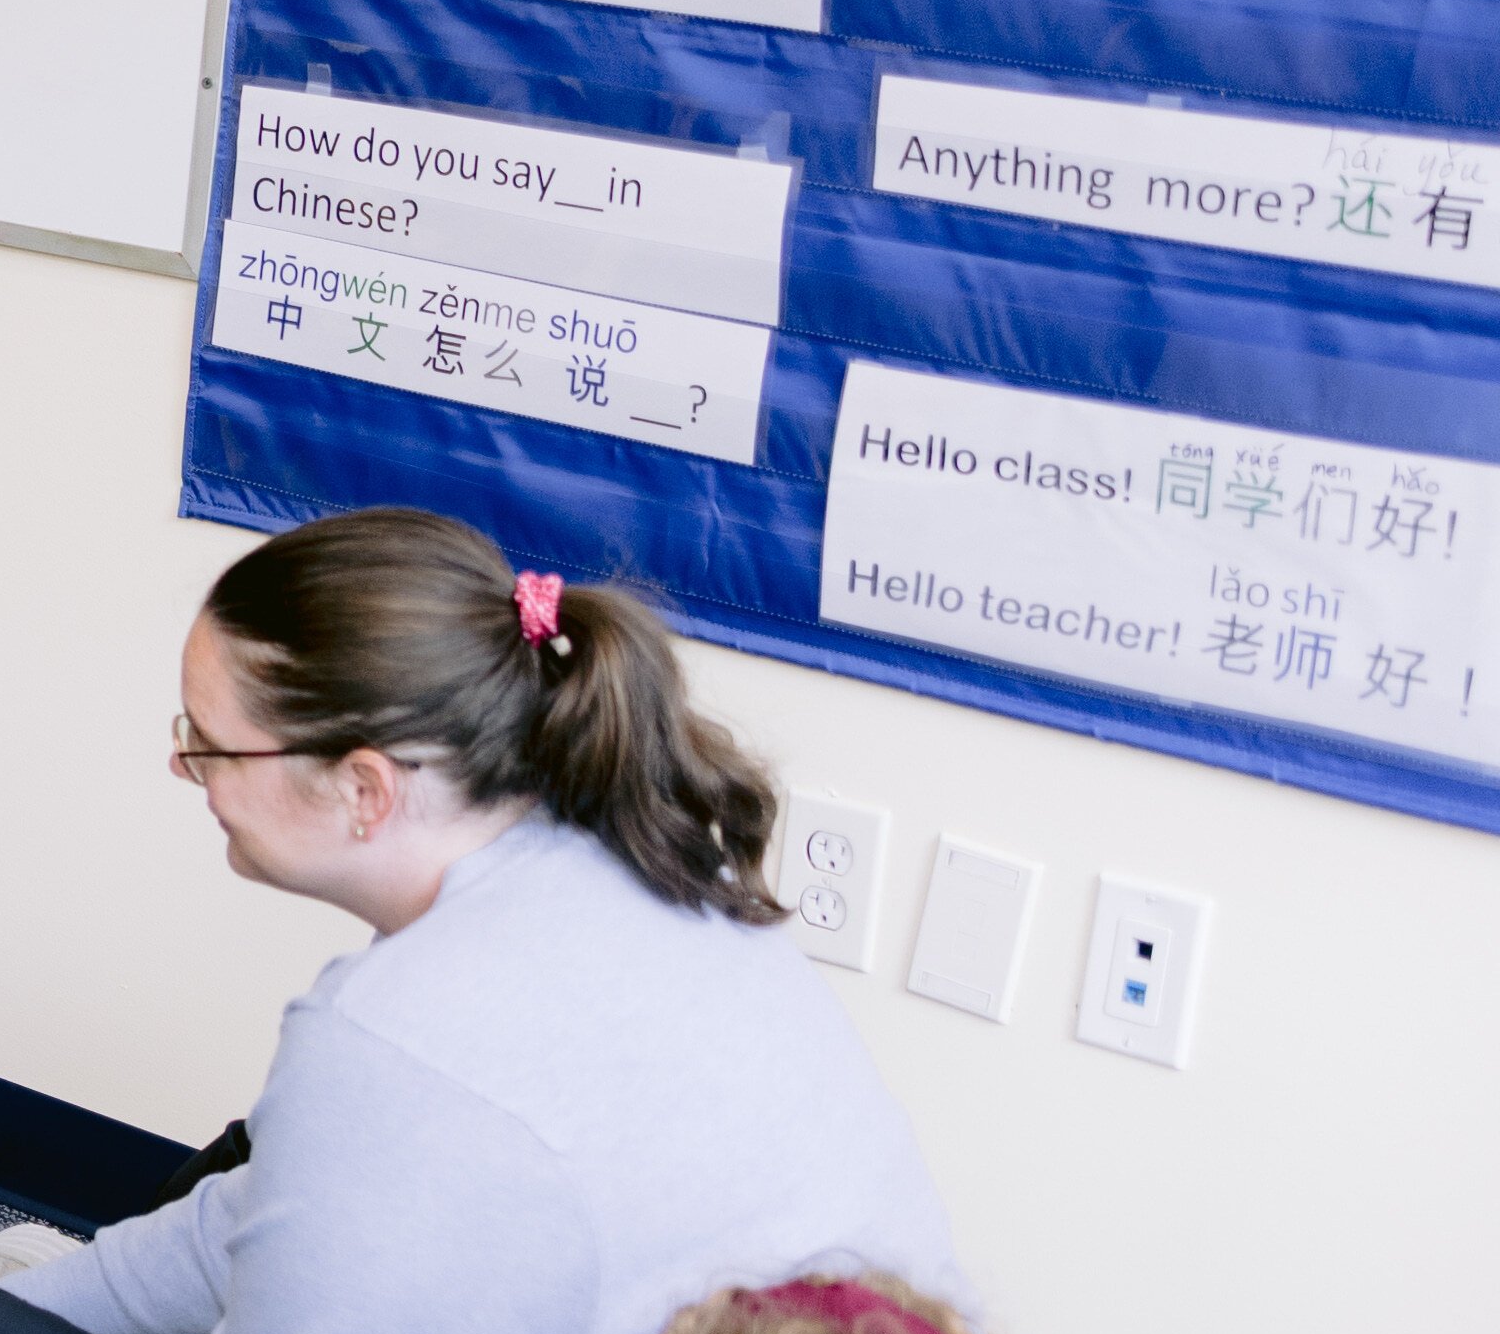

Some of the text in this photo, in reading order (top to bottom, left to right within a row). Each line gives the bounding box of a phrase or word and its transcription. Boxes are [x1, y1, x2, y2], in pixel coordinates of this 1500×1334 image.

[257, 114, 341, 158] How
[353, 123, 401, 168] do
[413, 140, 479, 183] you
[899, 133, 1115, 209] Anything
[1146, 173, 1316, 228] more?
[252, 176, 419, 238] Chinese?
[548, 308, 639, 356] shuō
[859, 423, 979, 478] Hello
[994, 451, 1134, 505] class!
[846, 558, 966, 616] Hello
[979, 585, 1182, 658] teacher!
[1209, 563, 1346, 623] lǎo shī
